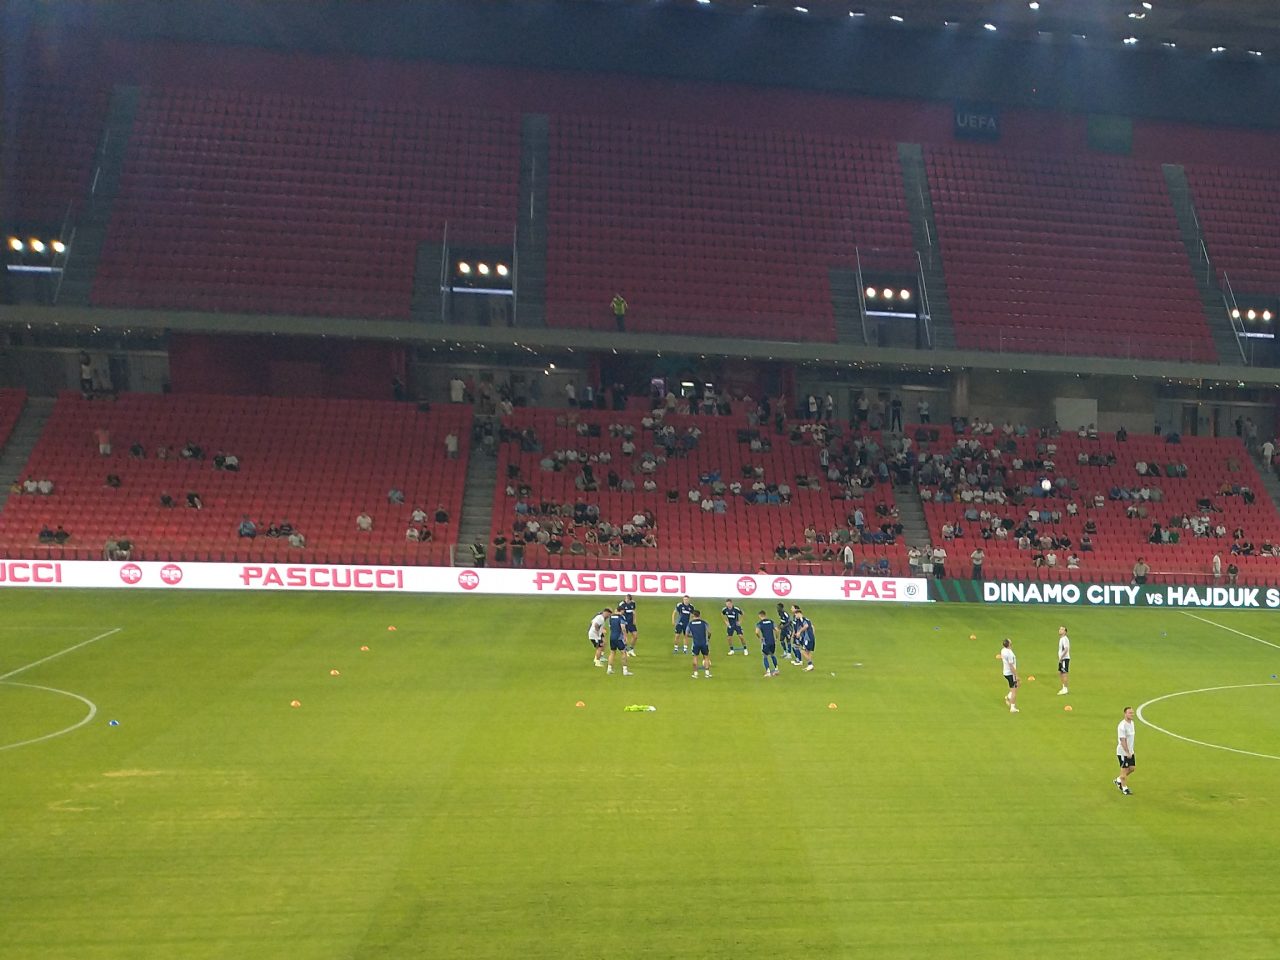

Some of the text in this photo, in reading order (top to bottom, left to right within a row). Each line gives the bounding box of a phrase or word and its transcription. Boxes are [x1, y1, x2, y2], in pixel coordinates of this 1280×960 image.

[956, 115, 996, 128] UEFA
[0, 563, 62, 583] CCI
[239, 566, 404, 589] PASCUCCI
[532, 572, 687, 594] PASCUCCI
[840, 579, 897, 599] PAS
[983, 582, 1081, 604] DINAMO
[1086, 584, 1140, 605] CITY
[1167, 586, 1260, 607] HAJDUK
